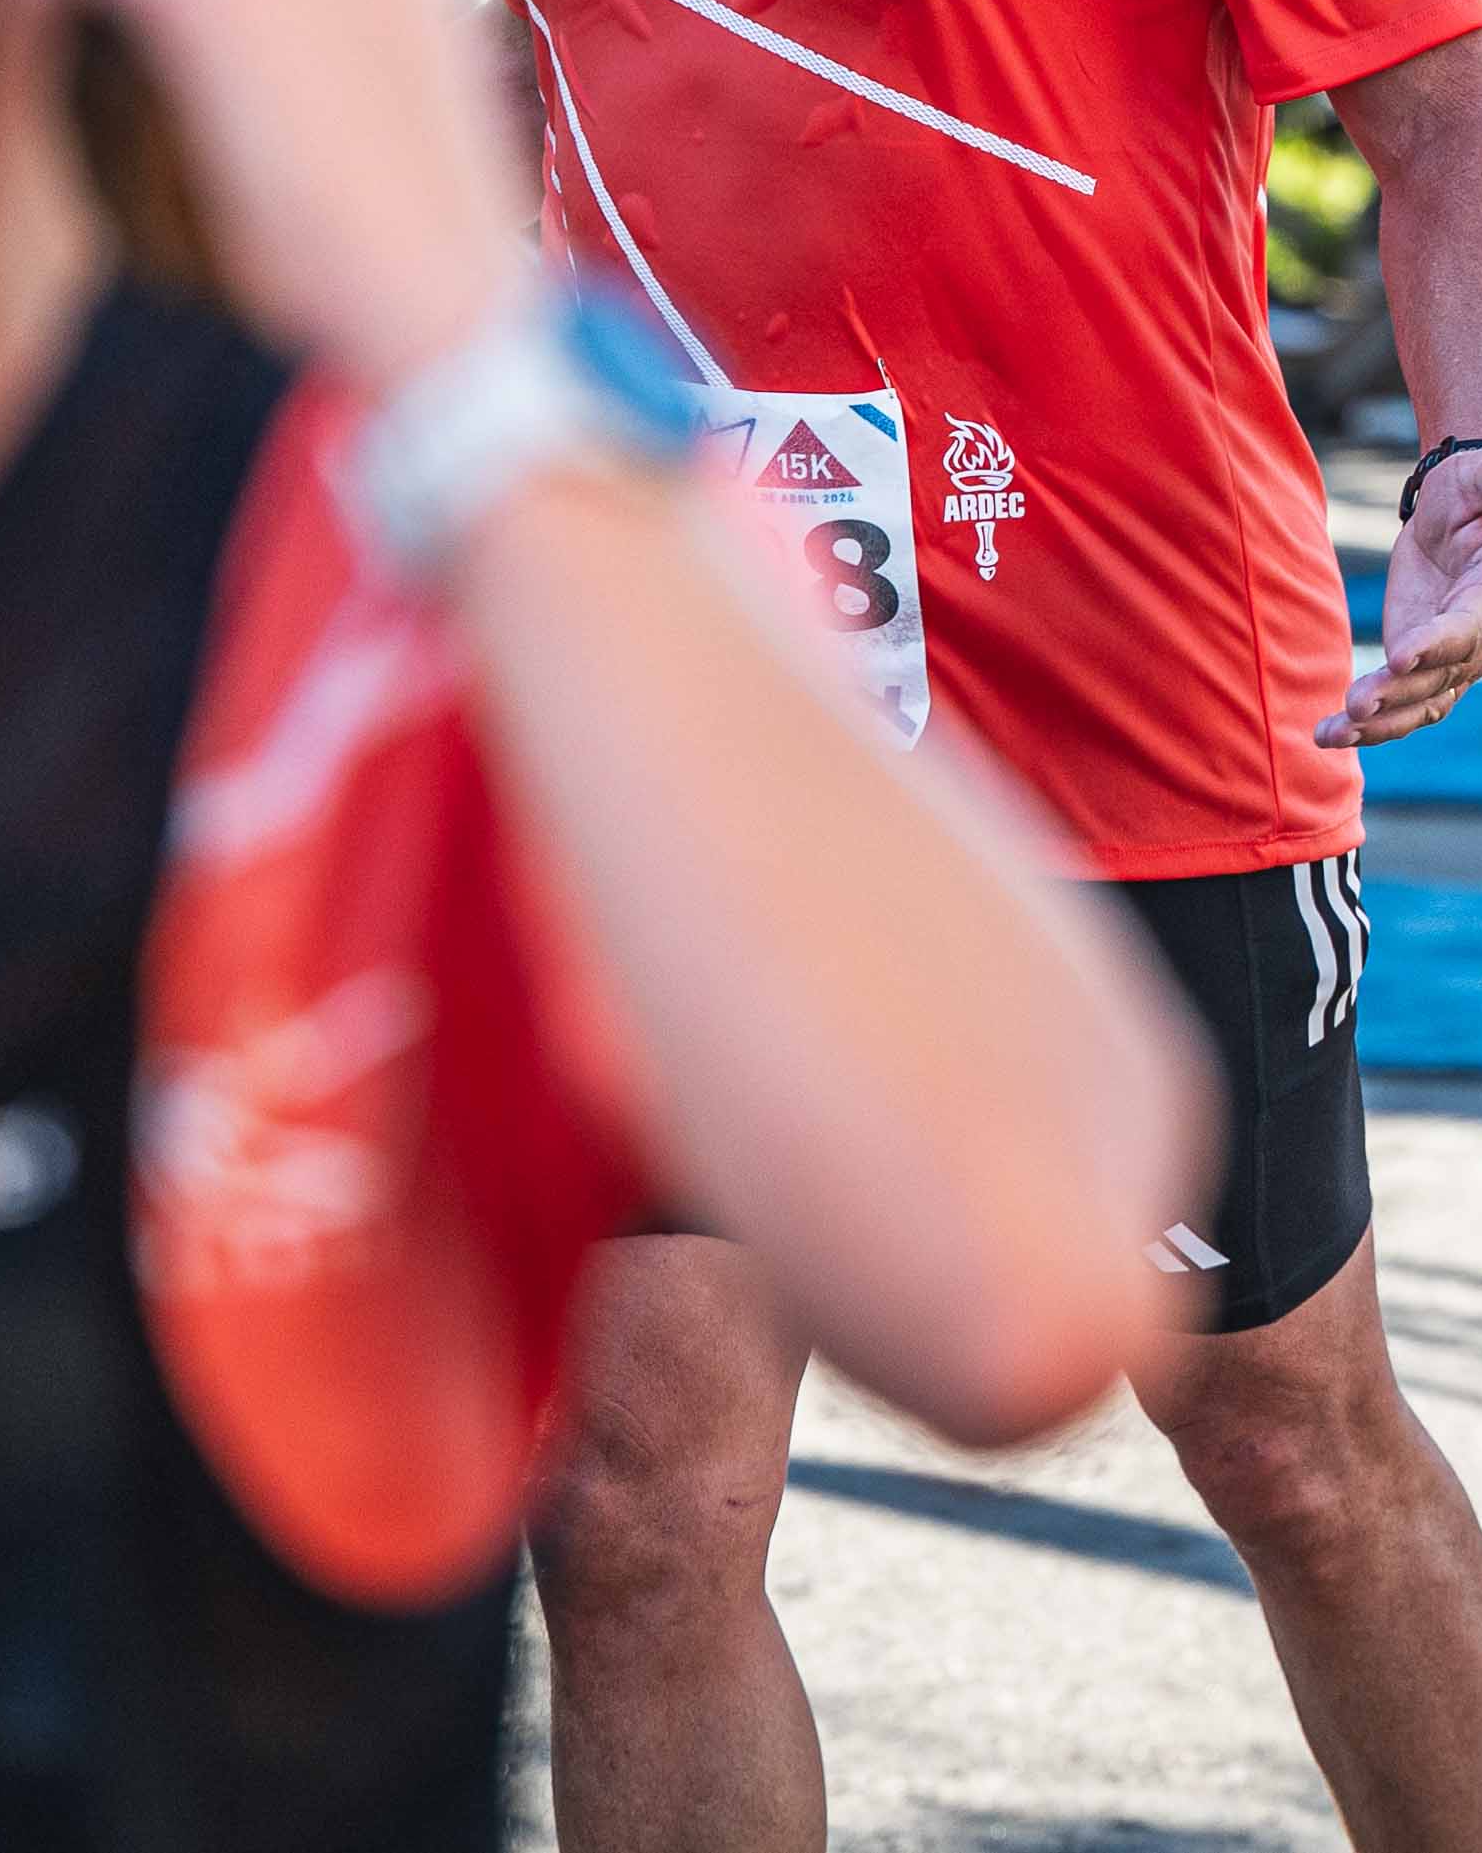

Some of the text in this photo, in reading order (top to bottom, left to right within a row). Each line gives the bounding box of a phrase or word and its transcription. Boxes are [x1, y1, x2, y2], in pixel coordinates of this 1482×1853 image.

[775, 453, 834, 480] 15K
[781, 492, 818, 505] ABRIL
[943, 492, 1026, 523] ARDEC
